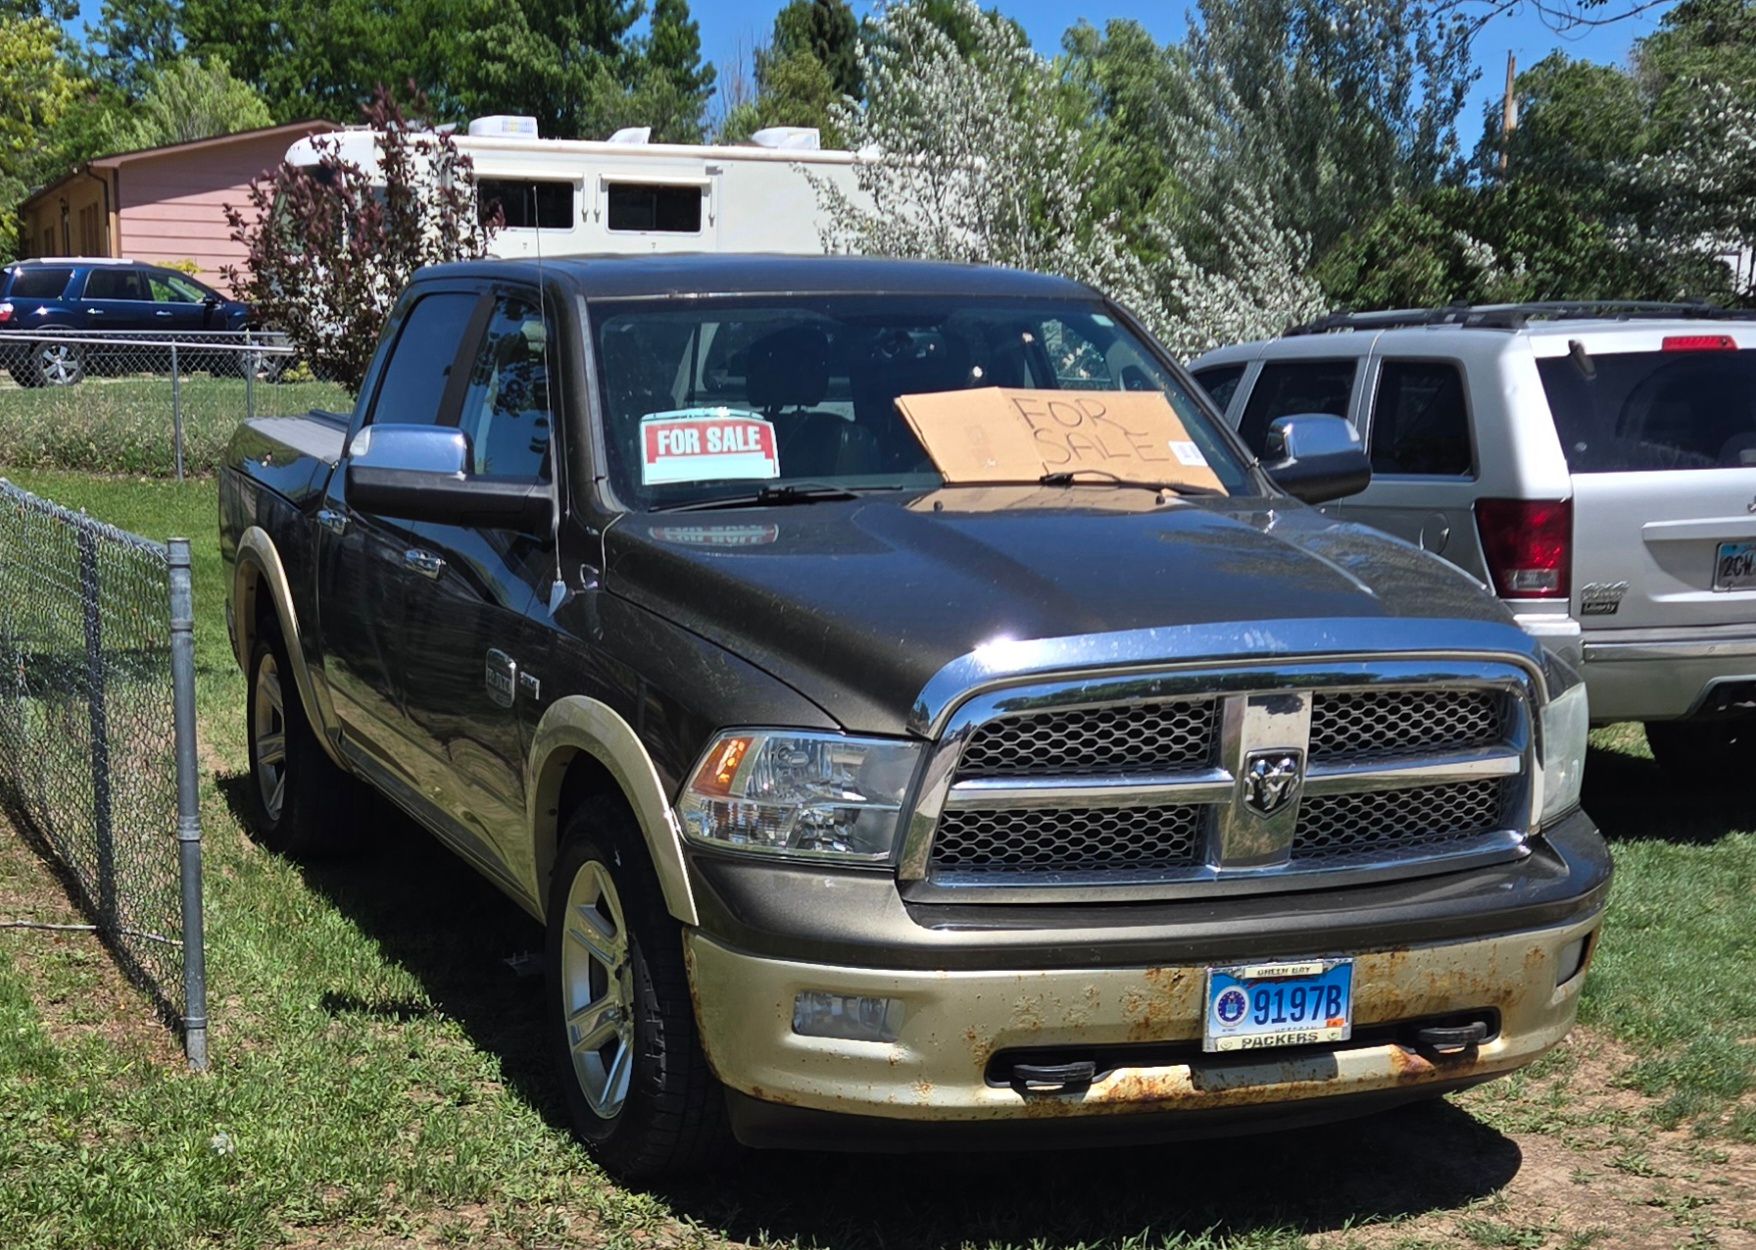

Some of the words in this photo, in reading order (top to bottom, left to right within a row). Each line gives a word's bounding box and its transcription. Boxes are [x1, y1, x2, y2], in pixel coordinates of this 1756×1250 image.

[1011, 397, 1128, 432] FOR
[657, 428, 700, 455] FOR
[706, 426, 761, 453] SALE
[1033, 428, 1169, 465] SALE
[1254, 984, 1342, 1026] 9197B
[1241, 1032, 1319, 1050] PACKERS
